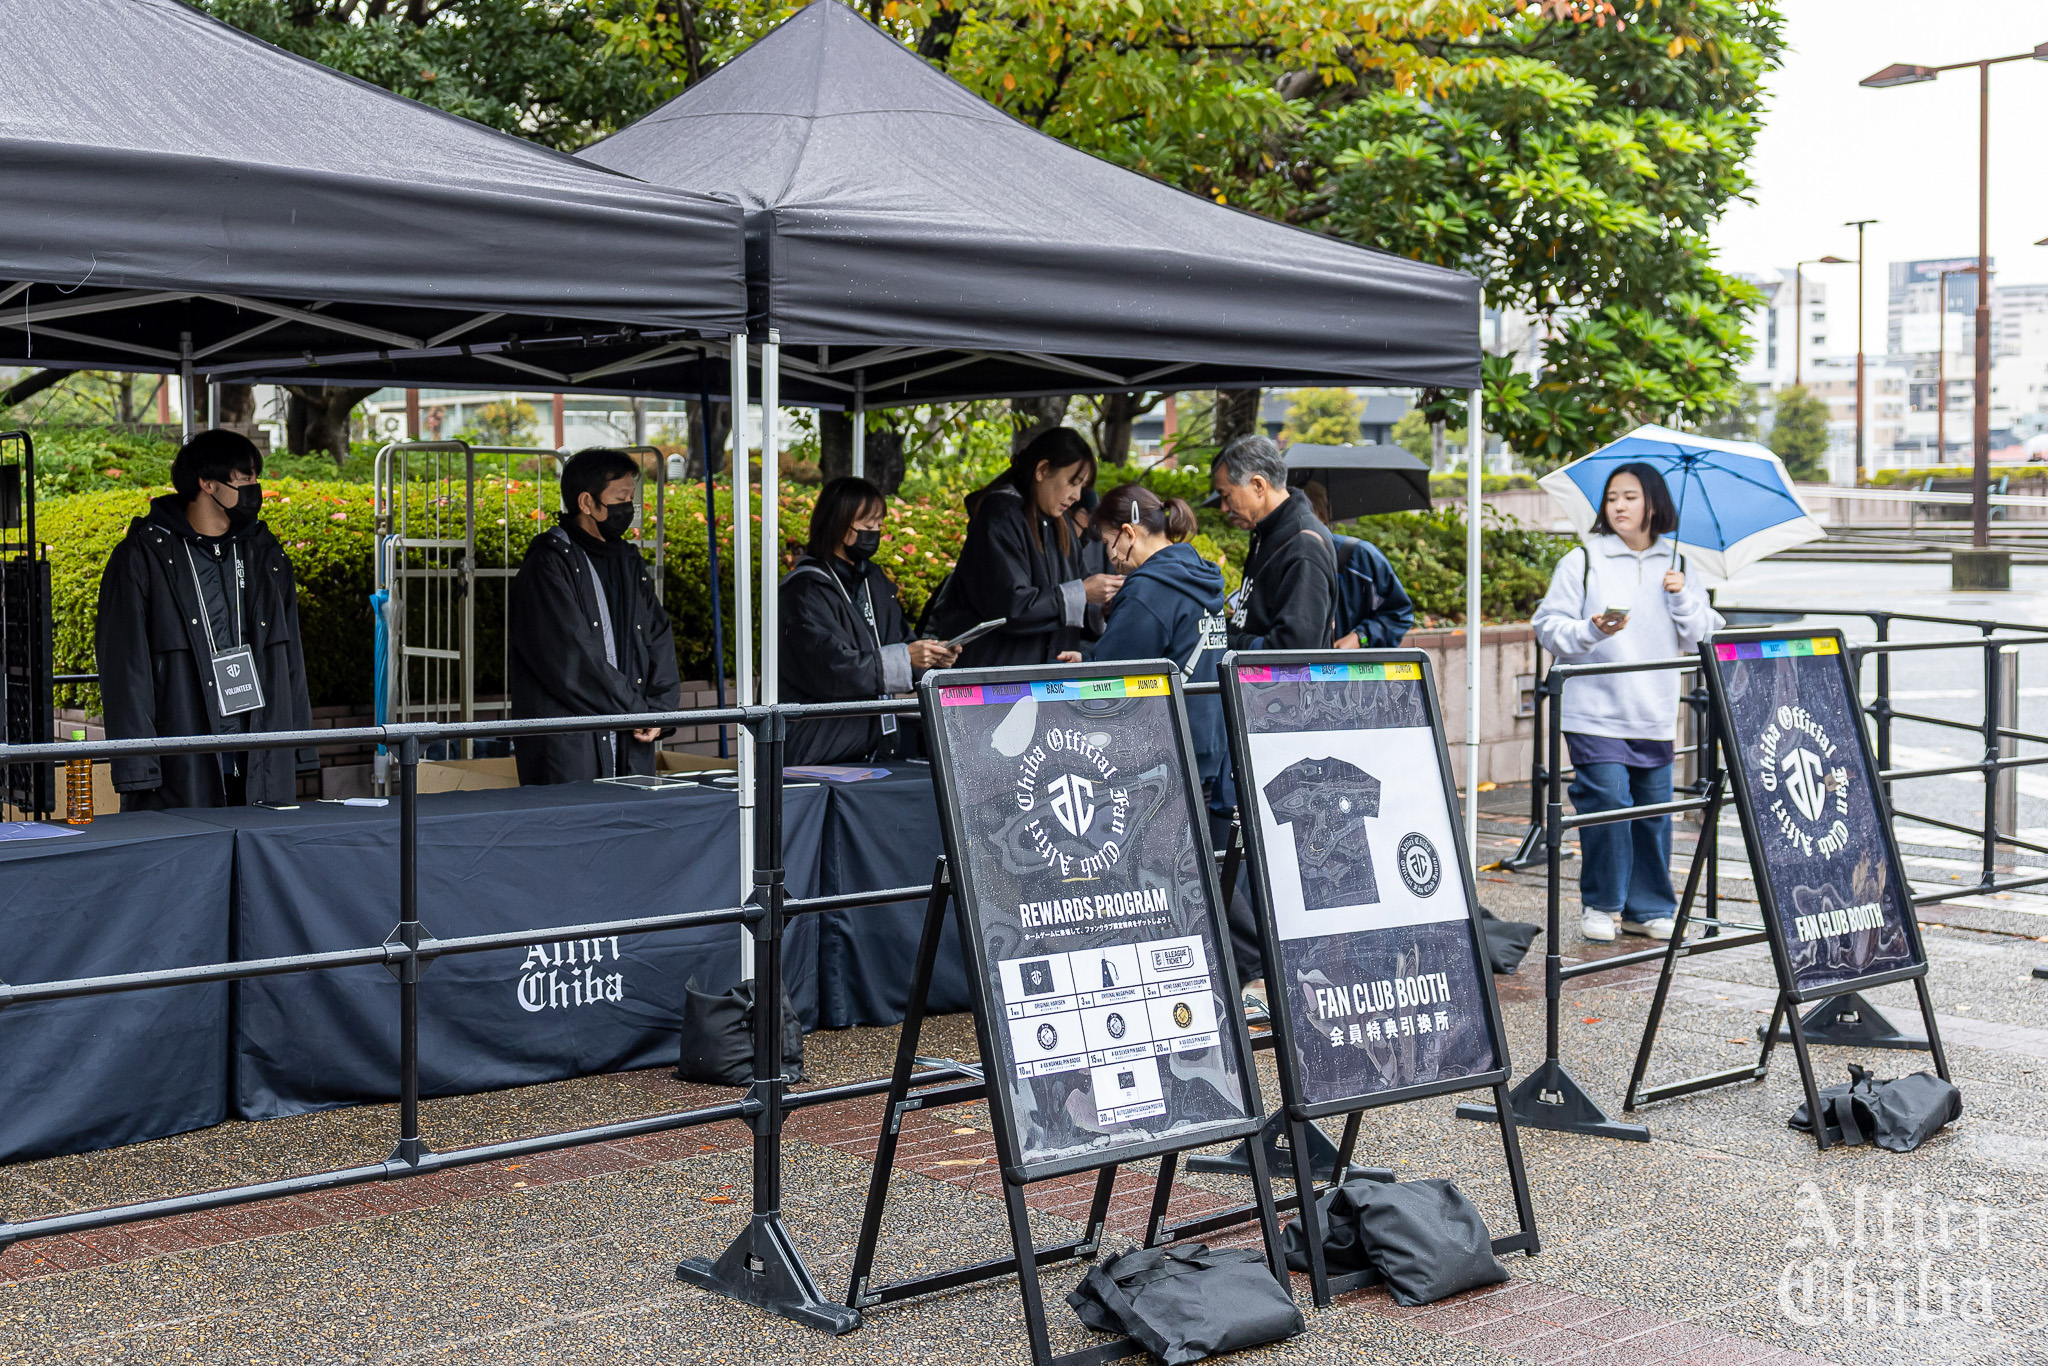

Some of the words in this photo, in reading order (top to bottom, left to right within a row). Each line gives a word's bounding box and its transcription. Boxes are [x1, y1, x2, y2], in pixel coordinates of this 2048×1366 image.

[224, 683, 253, 696] VOLUNTEER
[1045, 683, 1065, 694] BASIC
[1137, 679, 1158, 689] JUNIOR
[1321, 665, 1337, 675] BASIC
[1358, 665, 1374, 674] ENTRY
[940, 687, 974, 699] PLATINUM
[991, 684, 1022, 697] PREMIUM
[1777, 705, 1837, 758] Official
[1046, 727, 1118, 780] Official
[1759, 723, 1781, 792] Chiba
[1016, 745, 1047, 812] Chiba
[1830, 766, 1850, 816] Fan
[1109, 787, 1131, 836] Fan
[1080, 840, 1121, 879] Club
[1817, 819, 1849, 861] Club
[1019, 896, 1095, 928] REWARDS
[1093, 887, 1169, 919] PROGRAM
[1794, 914, 1821, 942] FAN
[1817, 909, 1850, 938] CLUB
[1845, 902, 1885, 933] BOOTH
[517, 965, 624, 1012] Chiba
[1315, 985, 1352, 1020] FAN
[1352, 979, 1396, 1015] CLUB
[1394, 972, 1451, 1008] BOOTH
[1329, 1010, 1450, 1048] 会員特典引換所
